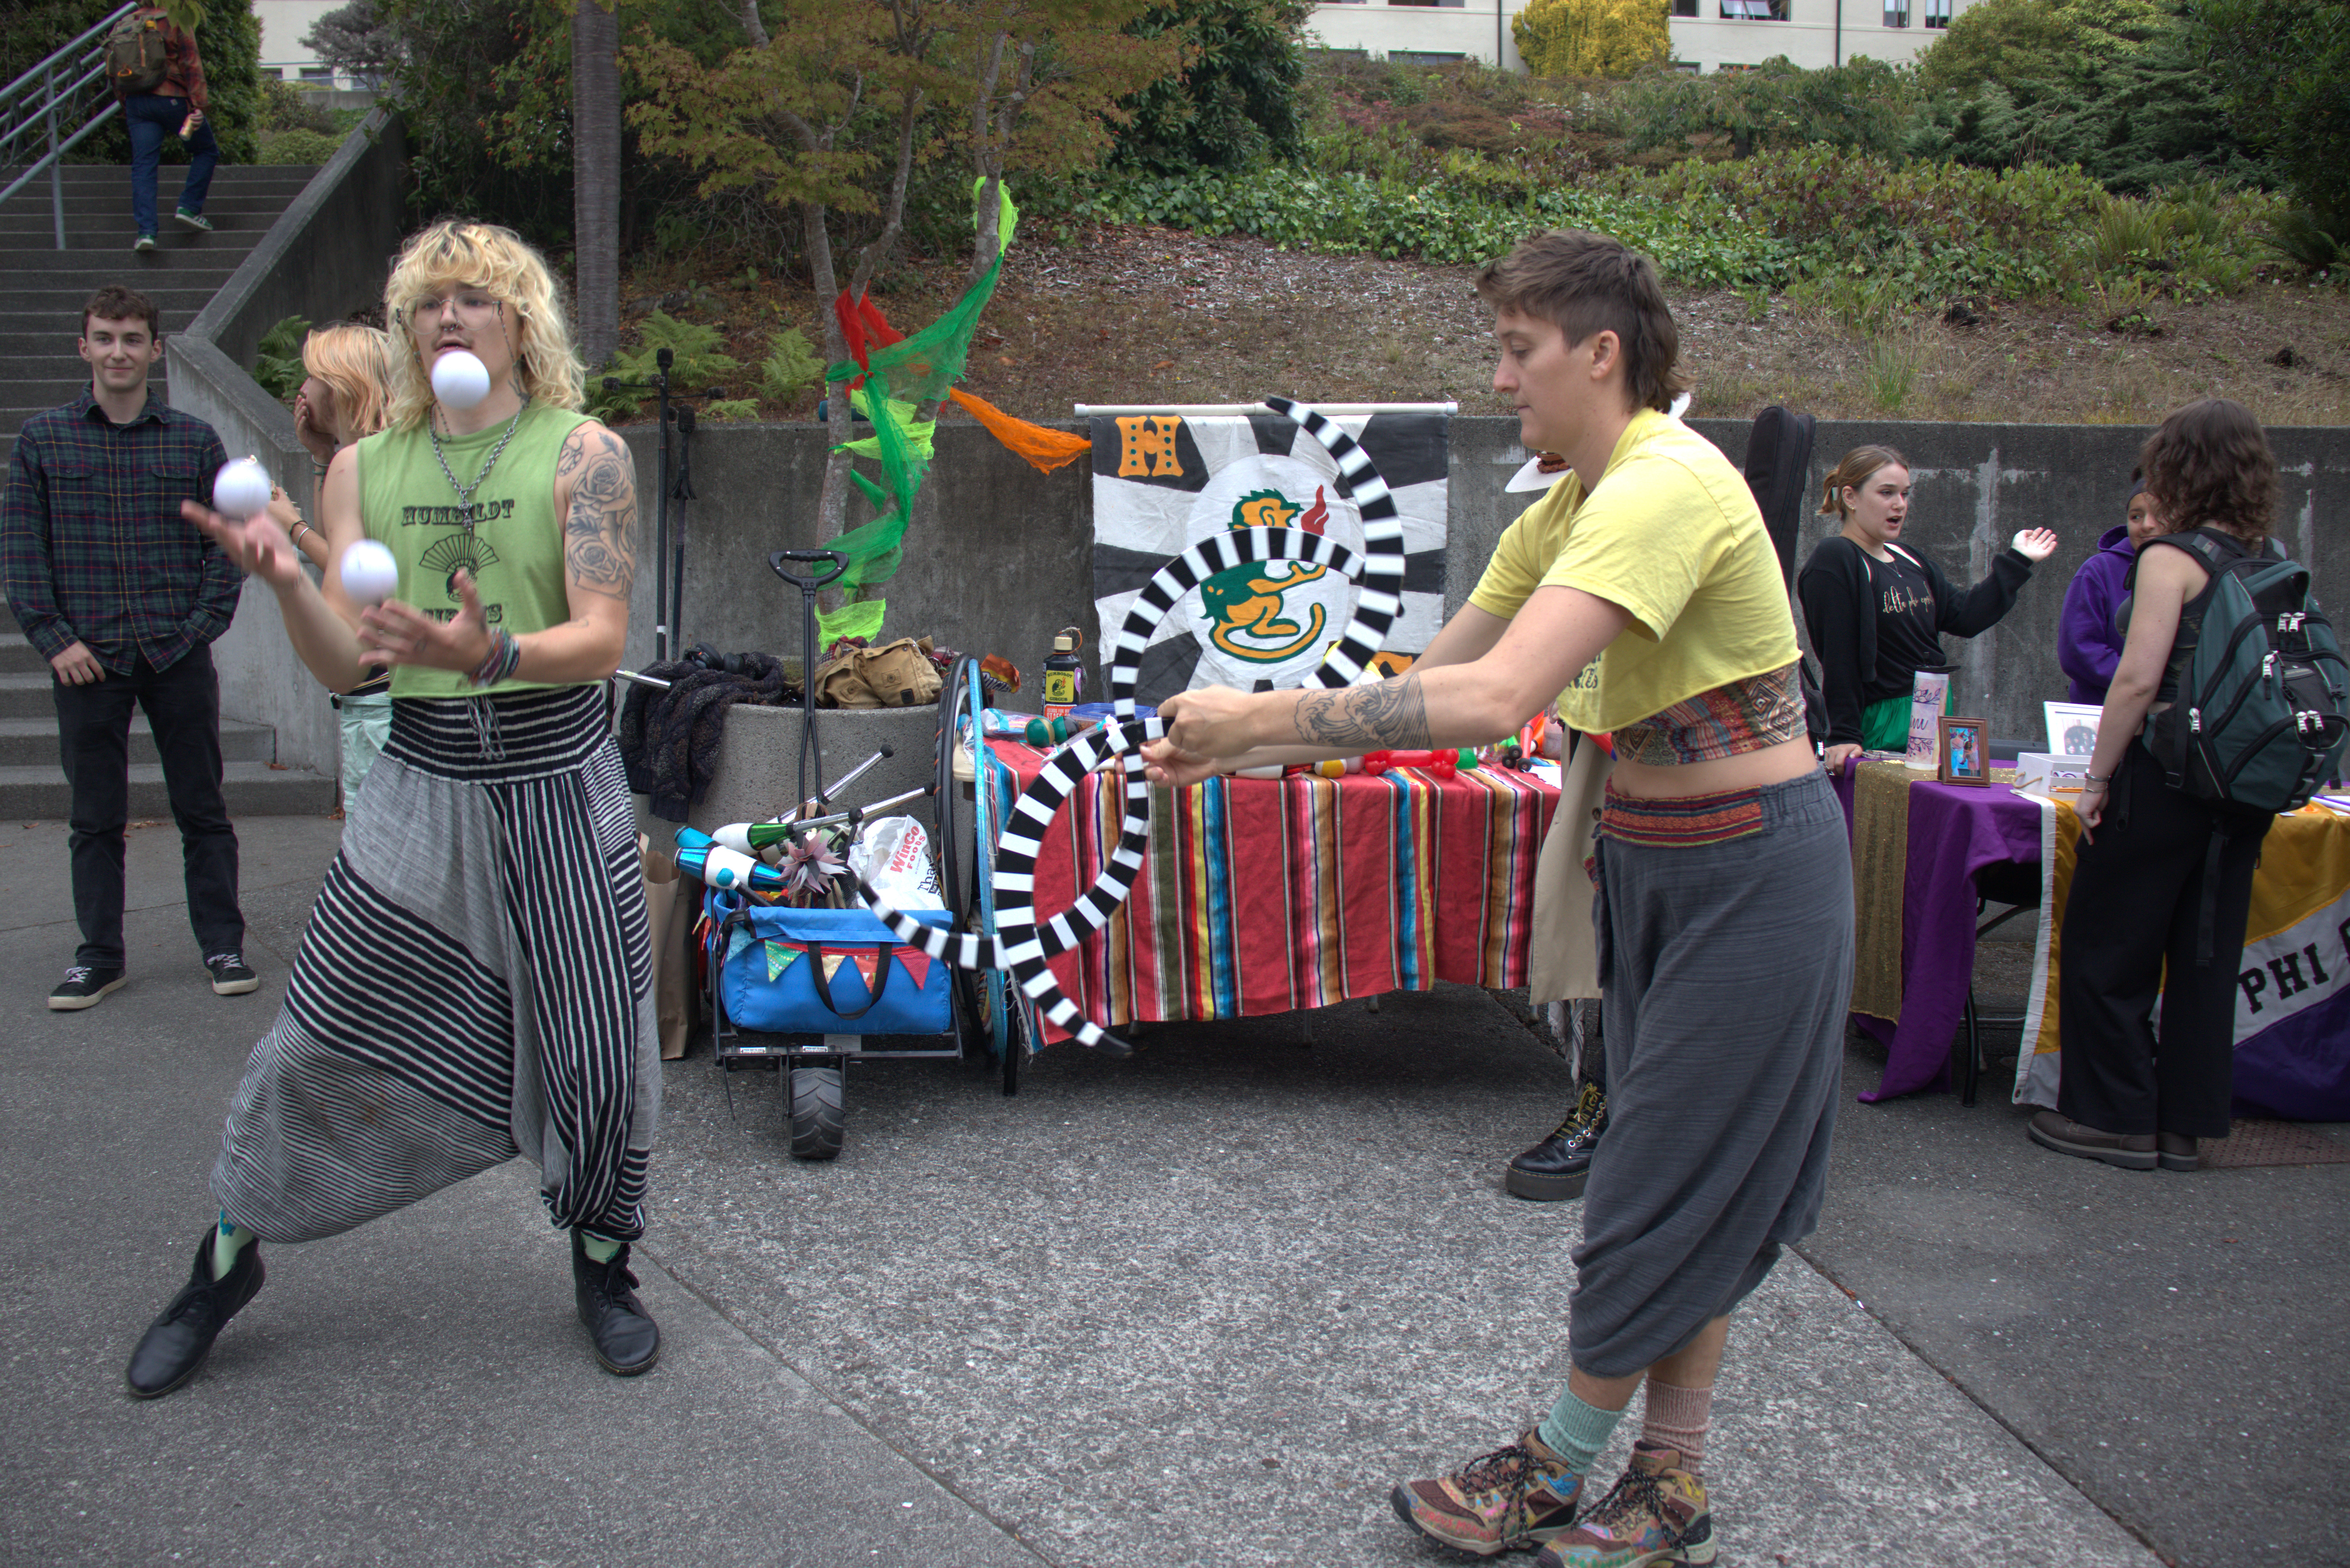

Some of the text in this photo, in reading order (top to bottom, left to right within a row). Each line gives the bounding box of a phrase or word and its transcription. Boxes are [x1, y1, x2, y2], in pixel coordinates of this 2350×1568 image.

[1115, 415, 1184, 477] H
[401, 499, 515, 526] HUMBLDT
[1883, 586, 1906, 614] delta
[1906, 587, 1919, 615] phi
[907, 835, 926, 869] FOODS
[2238, 942, 2330, 1015] PHI
[1418, 1506, 1454, 1528] CIRCUS
